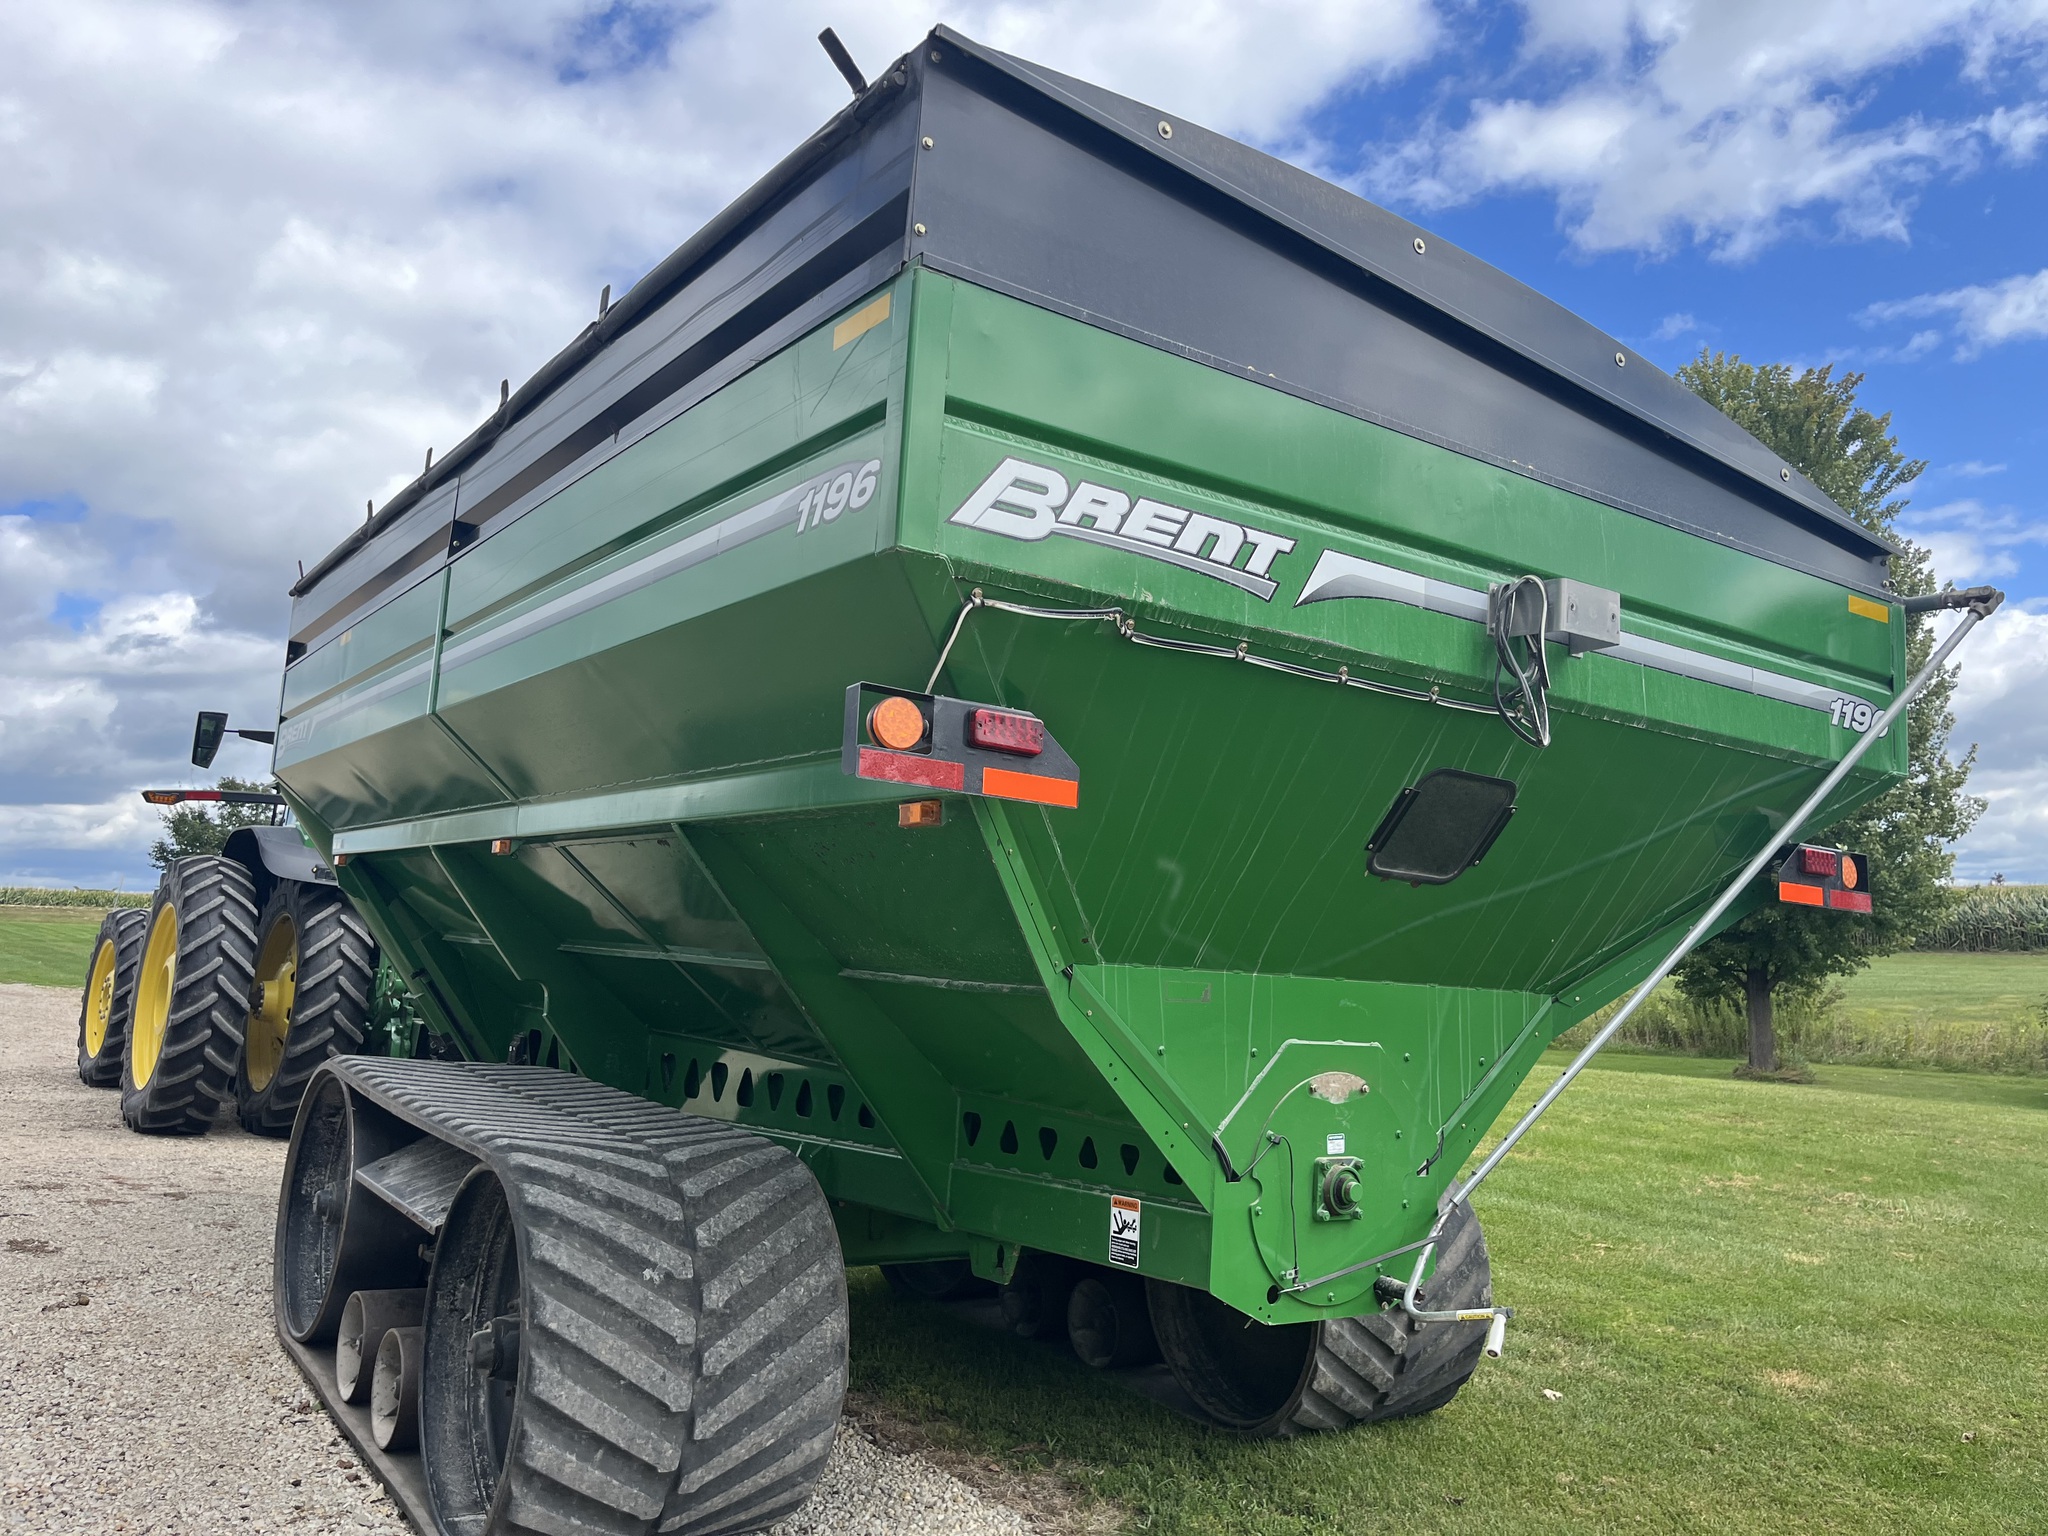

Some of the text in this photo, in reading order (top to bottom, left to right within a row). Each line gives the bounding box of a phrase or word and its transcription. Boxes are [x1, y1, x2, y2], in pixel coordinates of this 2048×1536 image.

[796, 459, 880, 534] 1196
[946, 456, 1297, 579] BRENT
[1118, 1200, 1138, 1209] WARNING
